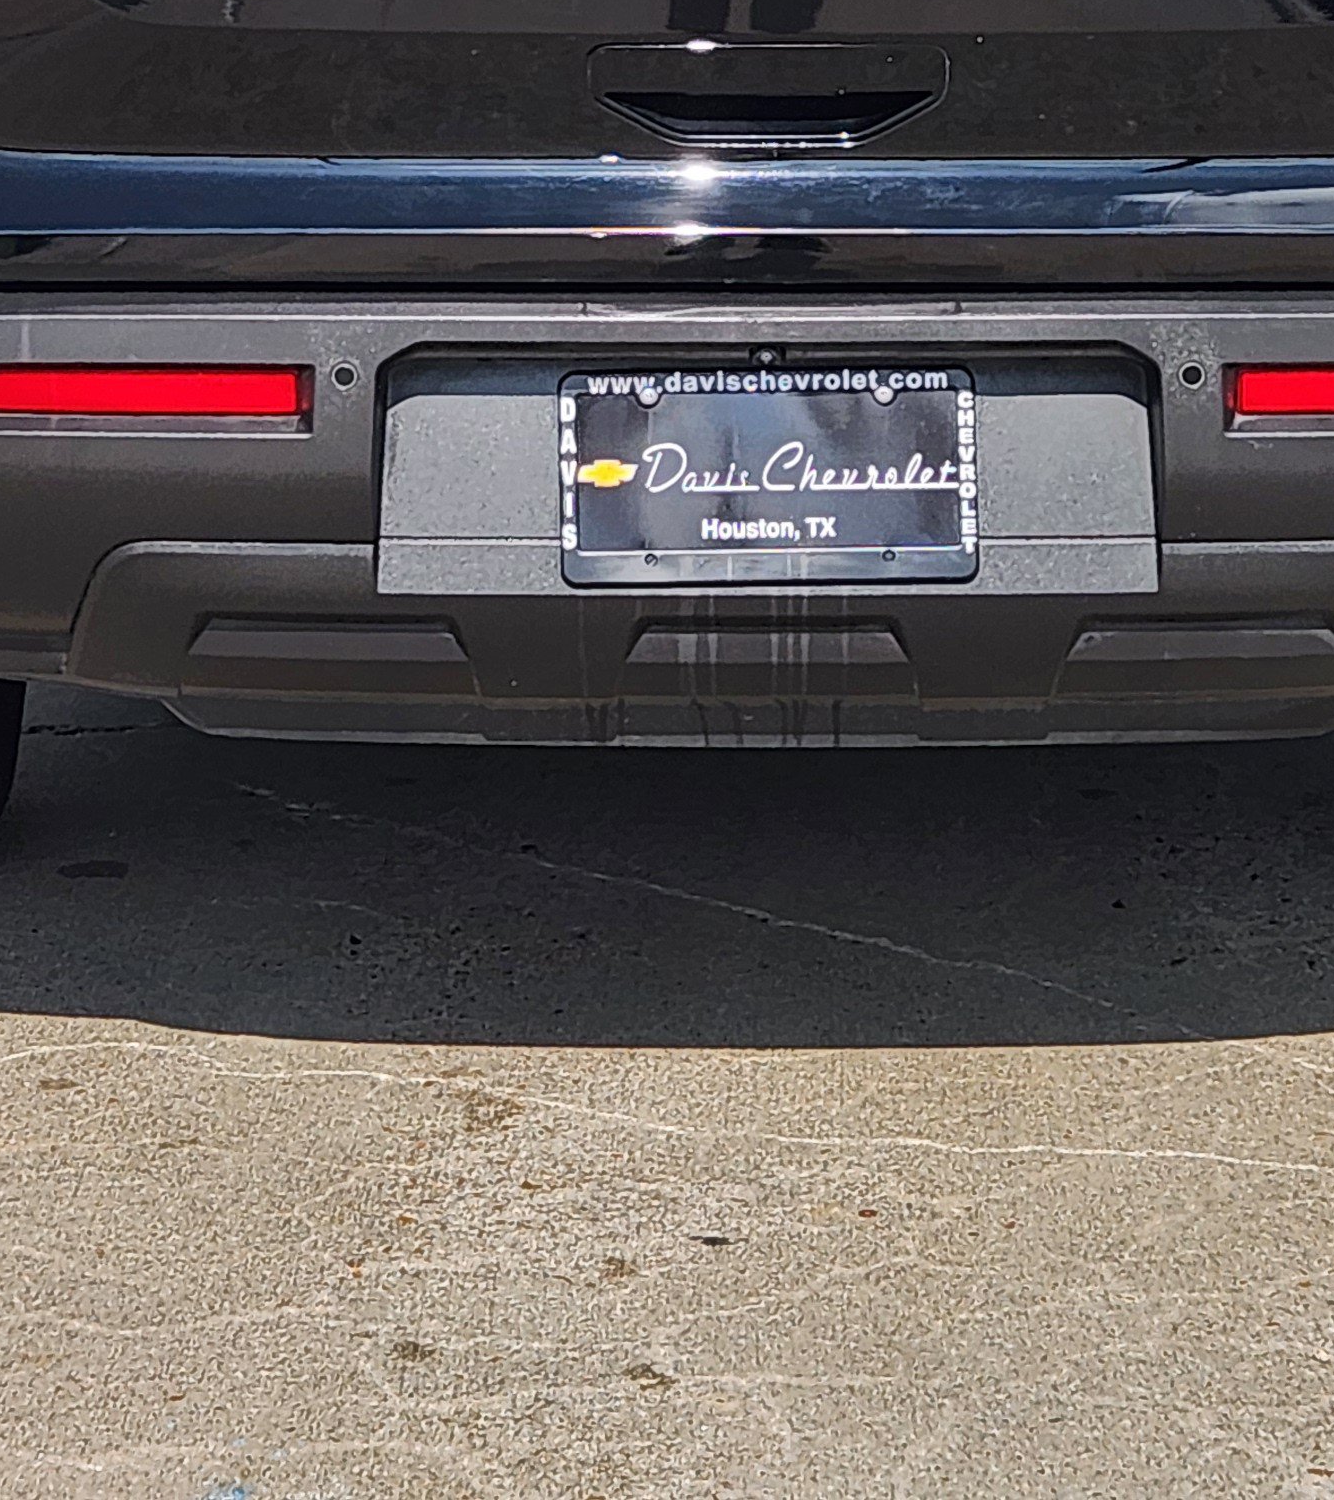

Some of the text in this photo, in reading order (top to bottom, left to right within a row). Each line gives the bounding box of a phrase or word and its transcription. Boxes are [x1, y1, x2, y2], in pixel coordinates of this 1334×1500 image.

[559, 396, 578, 551] DAVIS
[642, 441, 961, 493] Davis Chevrolet
[957, 391, 977, 553] CHEVROLET
[700, 517, 838, 541] Houston, TX
